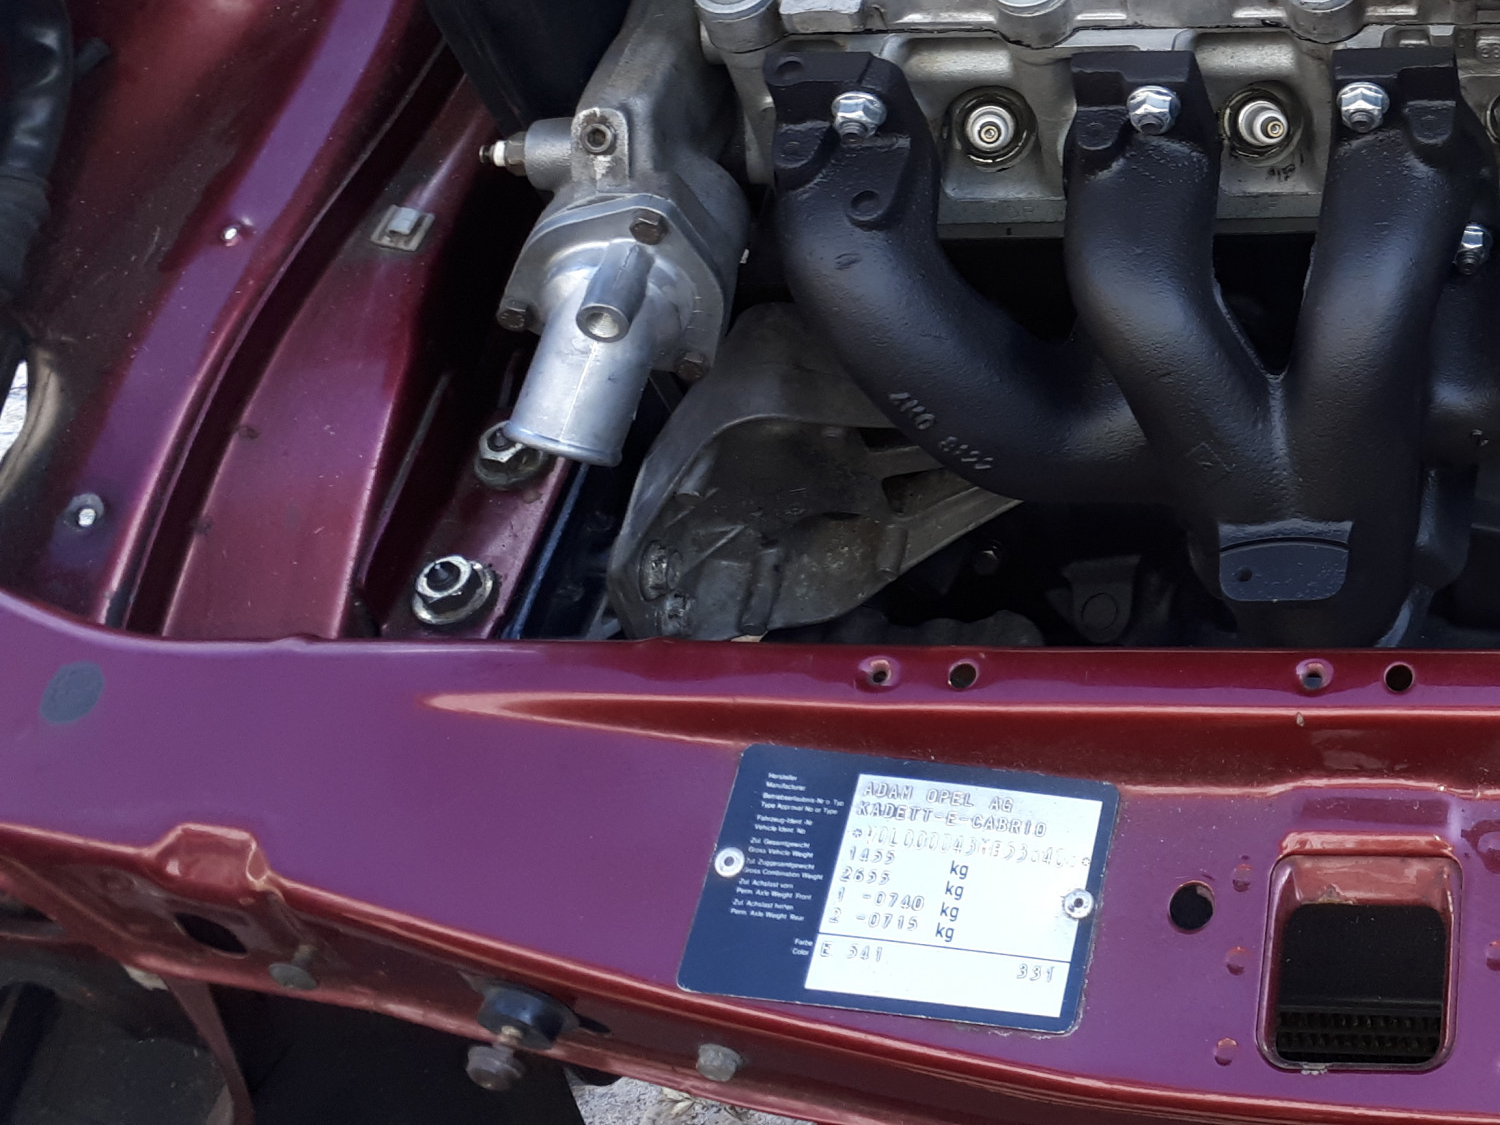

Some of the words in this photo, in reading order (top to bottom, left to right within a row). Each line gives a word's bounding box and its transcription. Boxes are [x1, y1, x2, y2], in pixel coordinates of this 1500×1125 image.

[864, 781, 914, 803] ADAM
[926, 788, 975, 808] OPEL
[988, 795, 1015, 814] AG
[857, 801, 1048, 838] KADETT-E-CABRIO
[950, 860, 969, 880] kg
[945, 881, 964, 901] kg
[940, 902, 960, 922] kg
[828, 907, 841, 925] 2
[935, 923, 955, 943] kg
[791, 947, 810, 956] Color
[794, 937, 814, 947] Farbe
